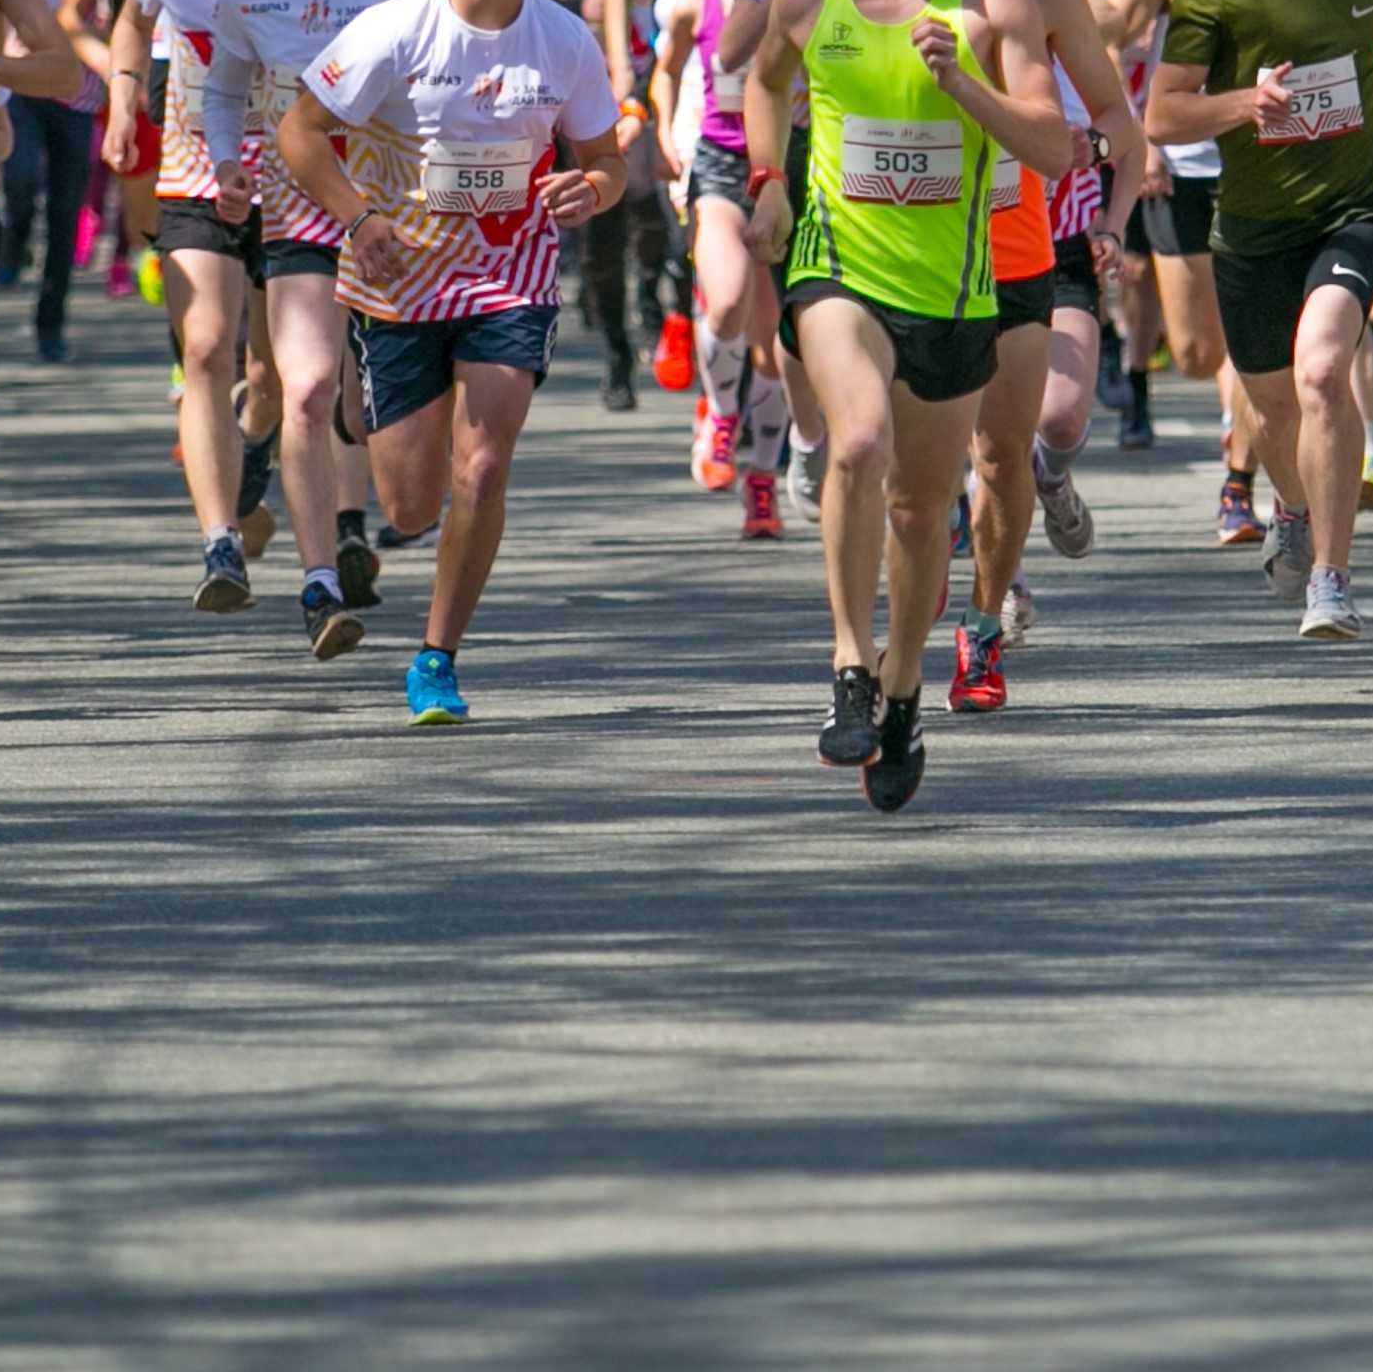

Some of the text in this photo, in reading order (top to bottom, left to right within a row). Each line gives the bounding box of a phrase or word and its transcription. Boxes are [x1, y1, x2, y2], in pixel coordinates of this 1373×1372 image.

[419, 74, 462, 87] ЕВРАЗ
[1290, 90, 1333, 115] 575
[874, 150, 929, 174] 503
[457, 169, 505, 189] 558
